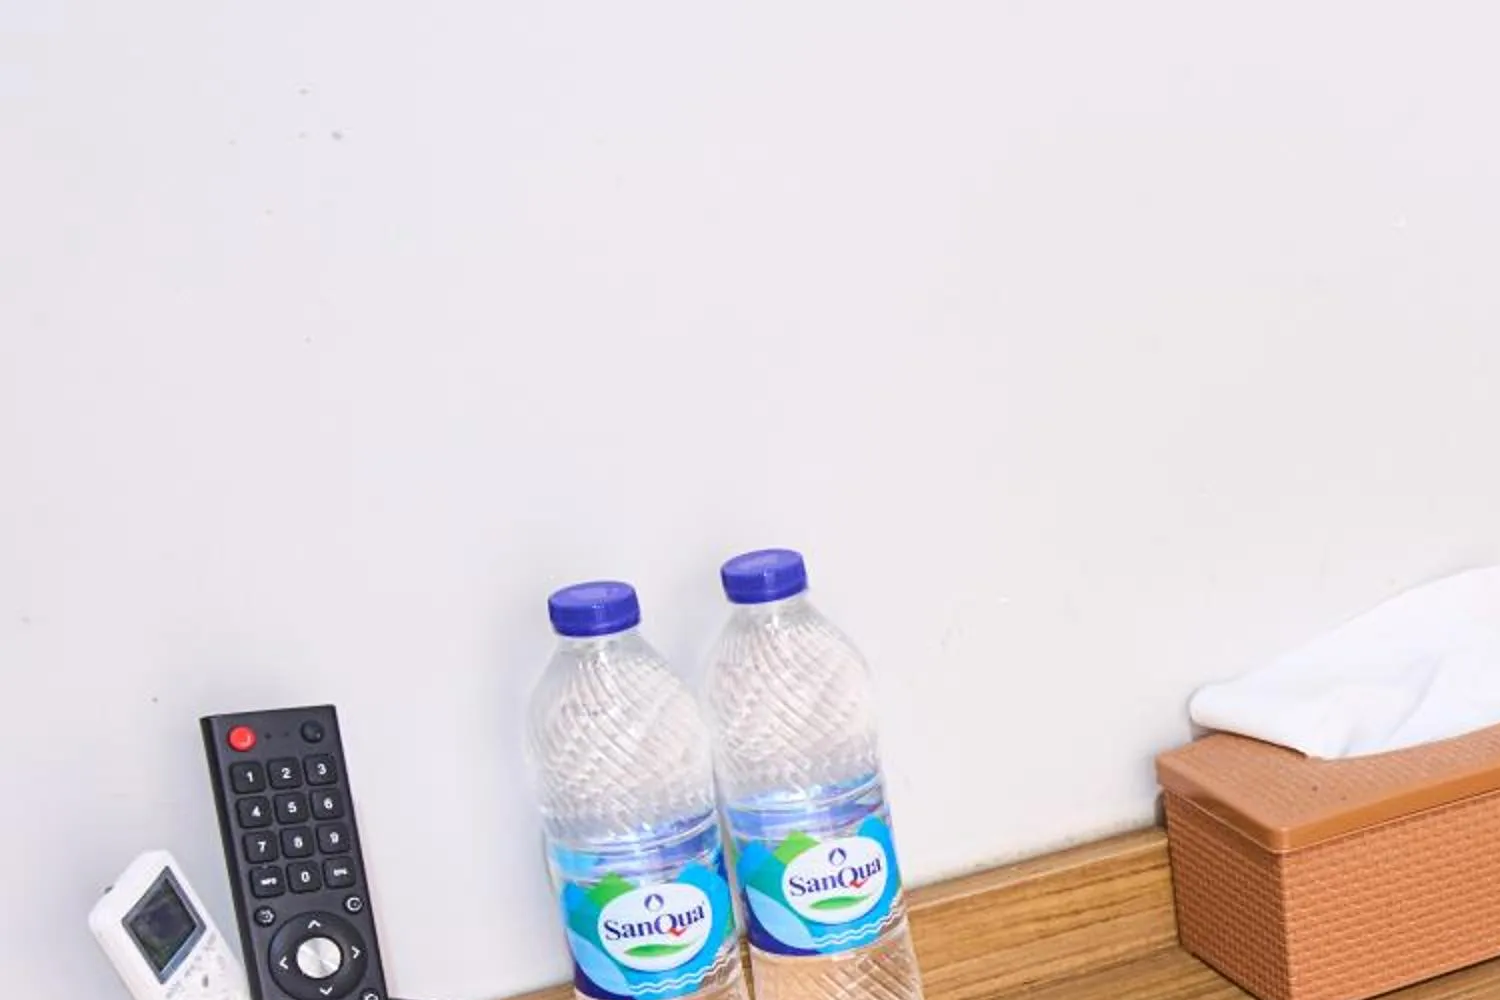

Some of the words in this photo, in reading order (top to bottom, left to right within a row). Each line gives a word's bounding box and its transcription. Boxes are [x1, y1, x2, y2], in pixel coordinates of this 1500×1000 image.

[281, 767, 292, 779] 2
[317, 763, 327, 775] 3
[287, 801, 297, 813] 5
[323, 797, 333, 809] 6
[251, 805, 261, 817] 4
[293, 836, 303, 849] 8
[329, 831, 339, 844] 9
[257, 840, 267, 853] 7
[301, 871, 310, 883] 0
[788, 854, 883, 898] SanQua
[603, 903, 705, 942] SanQua
